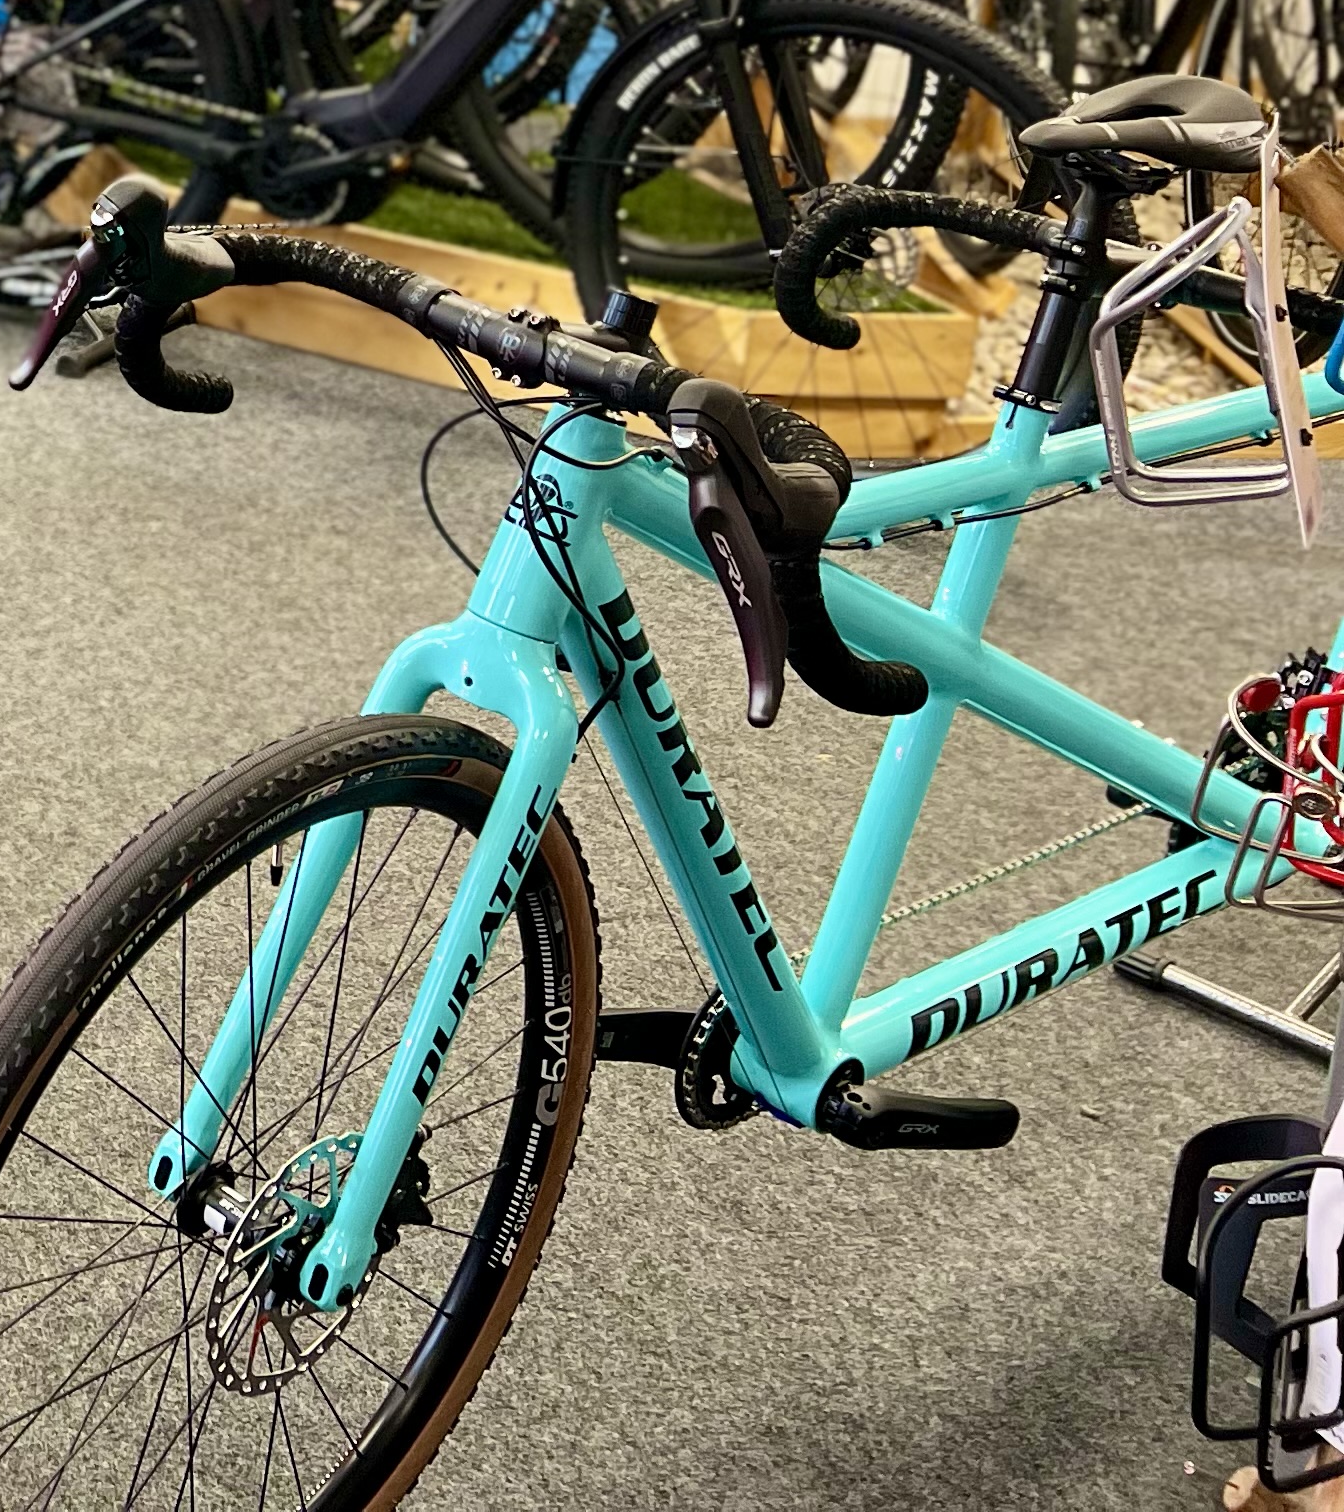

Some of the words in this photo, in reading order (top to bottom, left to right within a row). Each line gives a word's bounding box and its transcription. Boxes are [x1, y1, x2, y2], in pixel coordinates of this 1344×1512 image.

[881, 68, 940, 188] MAXXIS
[49, 269, 81, 319] GRX
[713, 531, 753, 607] GRX
[197, 840, 243, 883] GRAVEL
[246, 802, 301, 841] GRINDER
[412, 784, 557, 1107] DURATEC
[904, 869, 1218, 1061] DURATEC
[535, 1005, 572, 1126] G540
[898, 1123, 940, 1136] GRX
[501, 1236, 518, 1268] DT
[514, 1183, 540, 1234] SWISS
[1247, 1189, 1311, 1206] SLIDECA
